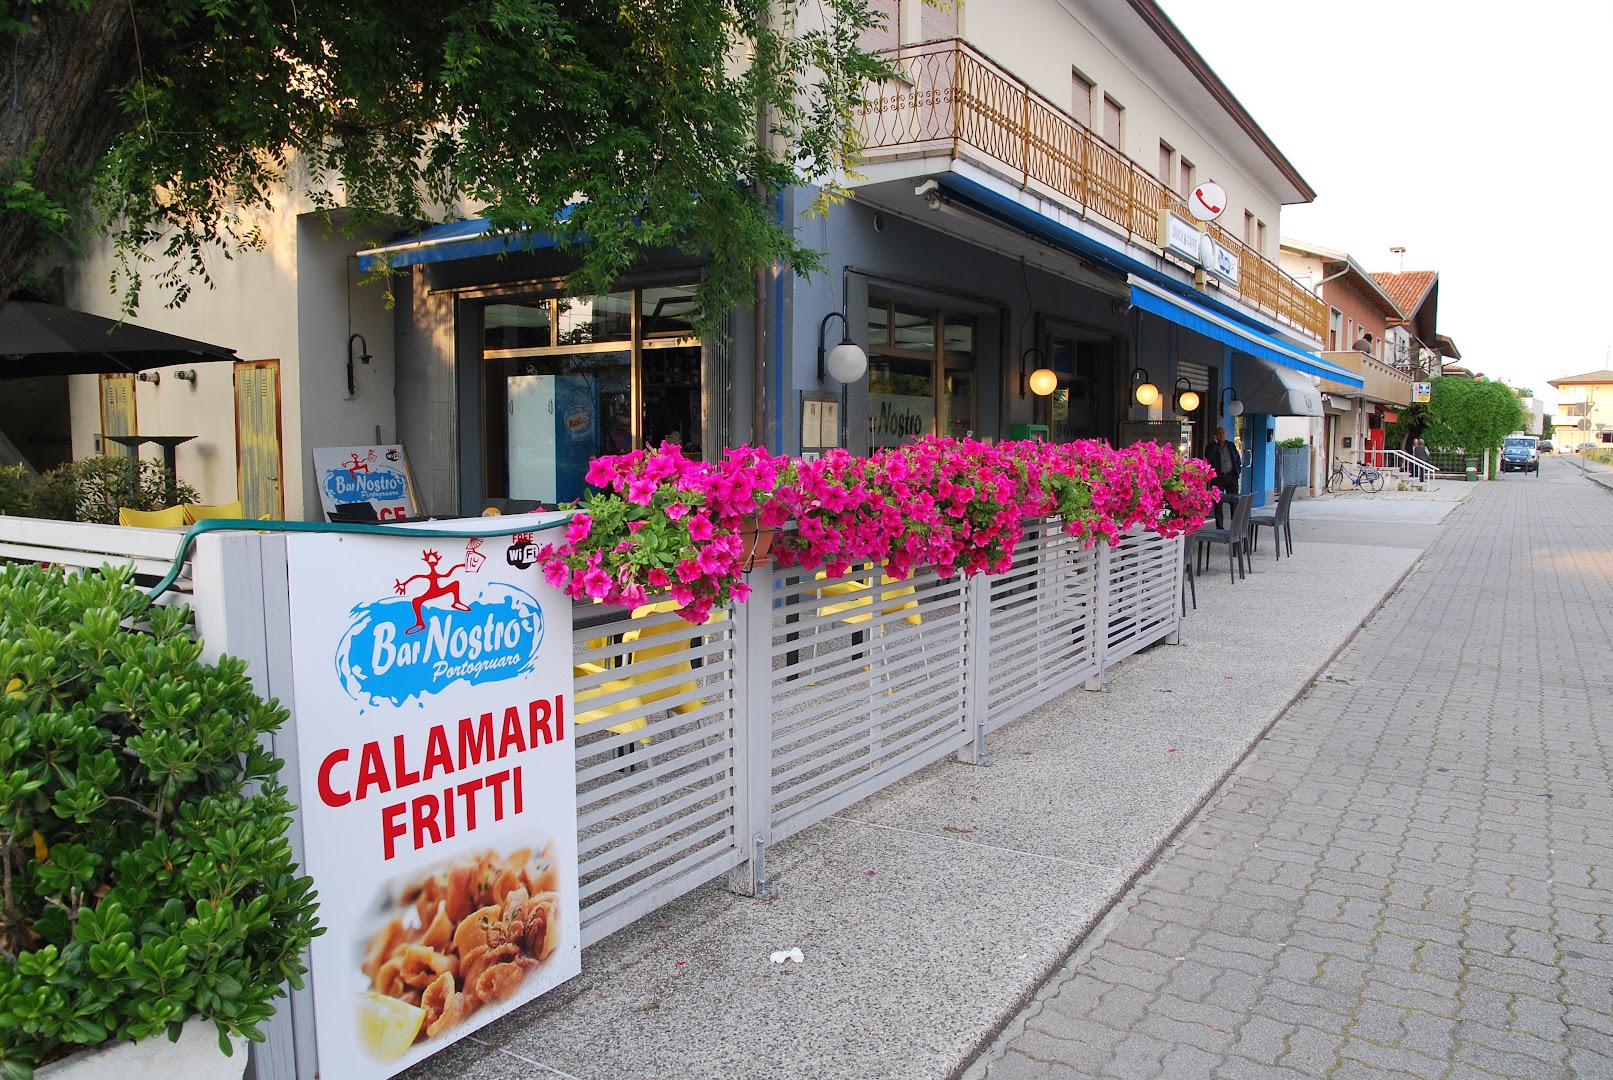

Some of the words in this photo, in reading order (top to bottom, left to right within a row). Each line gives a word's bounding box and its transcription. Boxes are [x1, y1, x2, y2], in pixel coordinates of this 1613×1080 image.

[878, 401, 921, 438] Nostro
[335, 476, 355, 493] Bar
[356, 475, 397, 492] Nostro
[512, 533, 534, 544] FREE
[371, 621, 421, 676] Bar
[422, 612, 521, 661] Nostro
[432, 653, 521, 683] Portogruaro
[317, 694, 565, 808] CALAMARI
[381, 765, 524, 862] FRITTI
